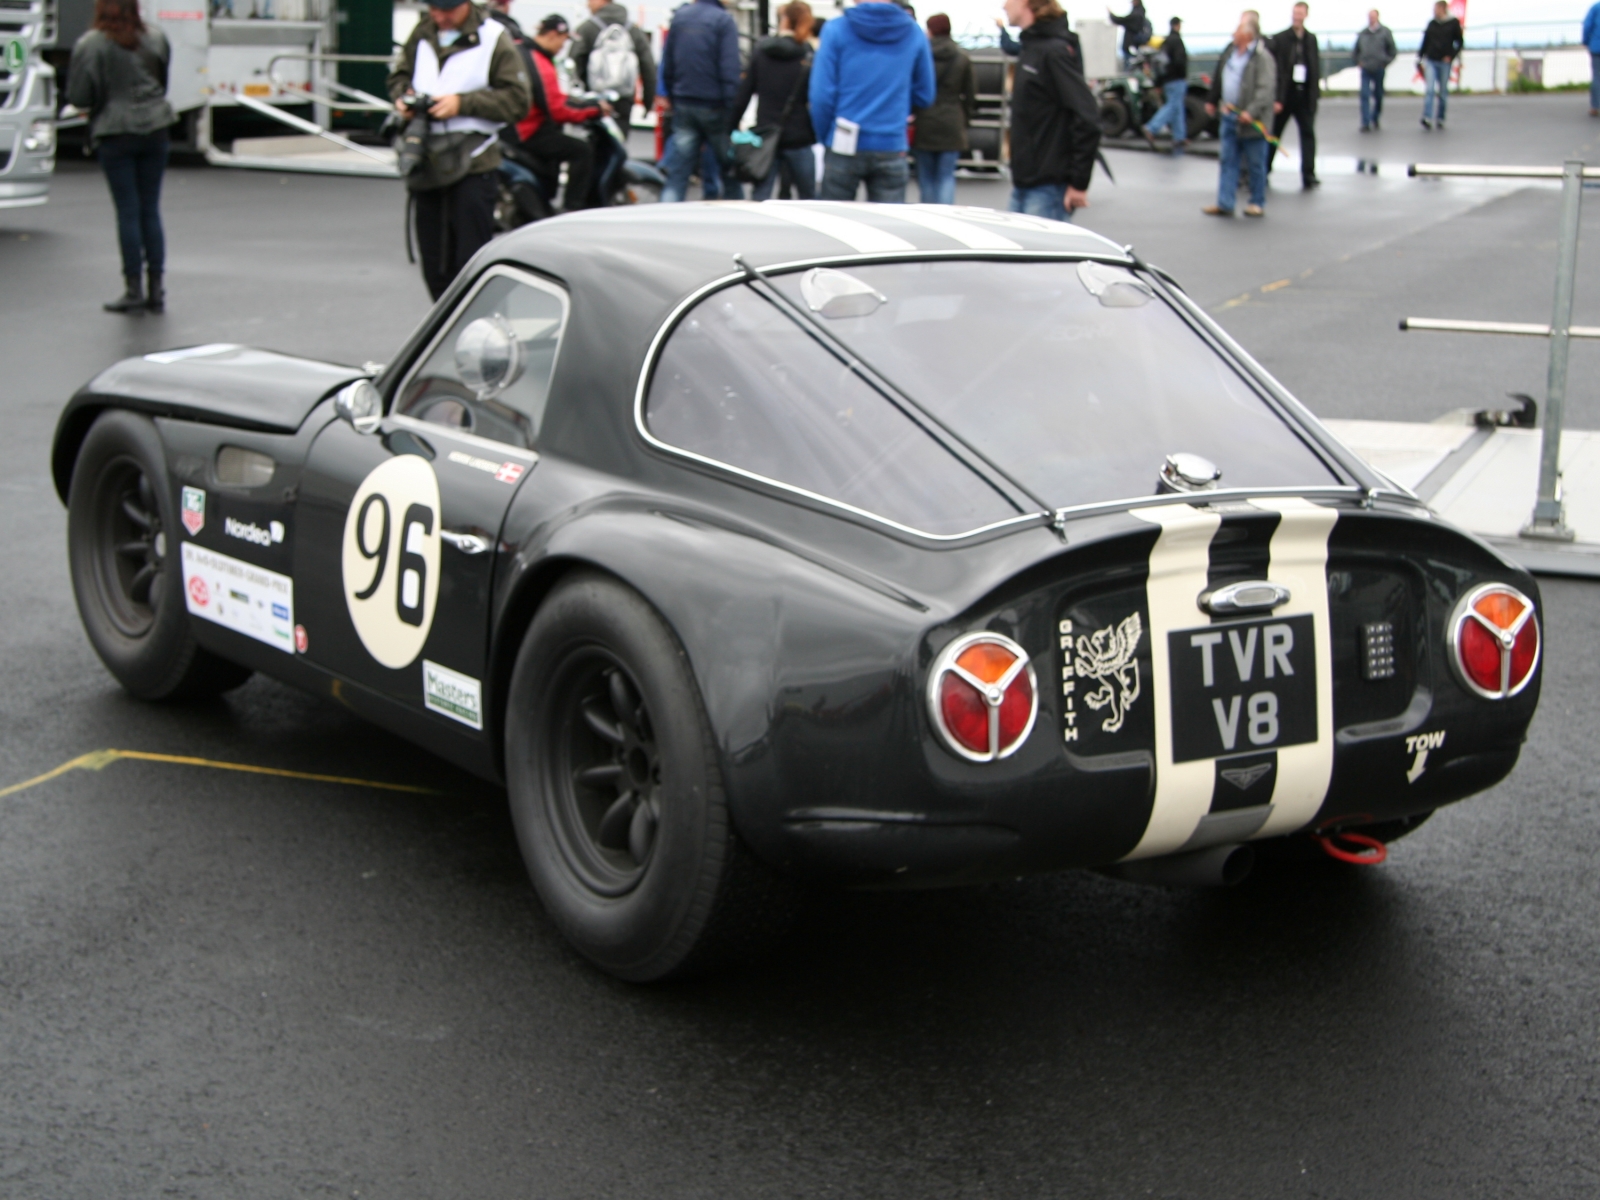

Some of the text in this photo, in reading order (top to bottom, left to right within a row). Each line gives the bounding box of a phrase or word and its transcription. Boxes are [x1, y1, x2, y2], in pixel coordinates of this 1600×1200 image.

[225, 516, 272, 547] Nordea
[354, 492, 434, 629] 96
[1059, 619, 1079, 742] GRIFFITH
[1190, 623, 1294, 687] TVR
[427, 669, 478, 710] Masters
[1211, 691, 1279, 750] V8
[1405, 730, 1446, 754] TOW
